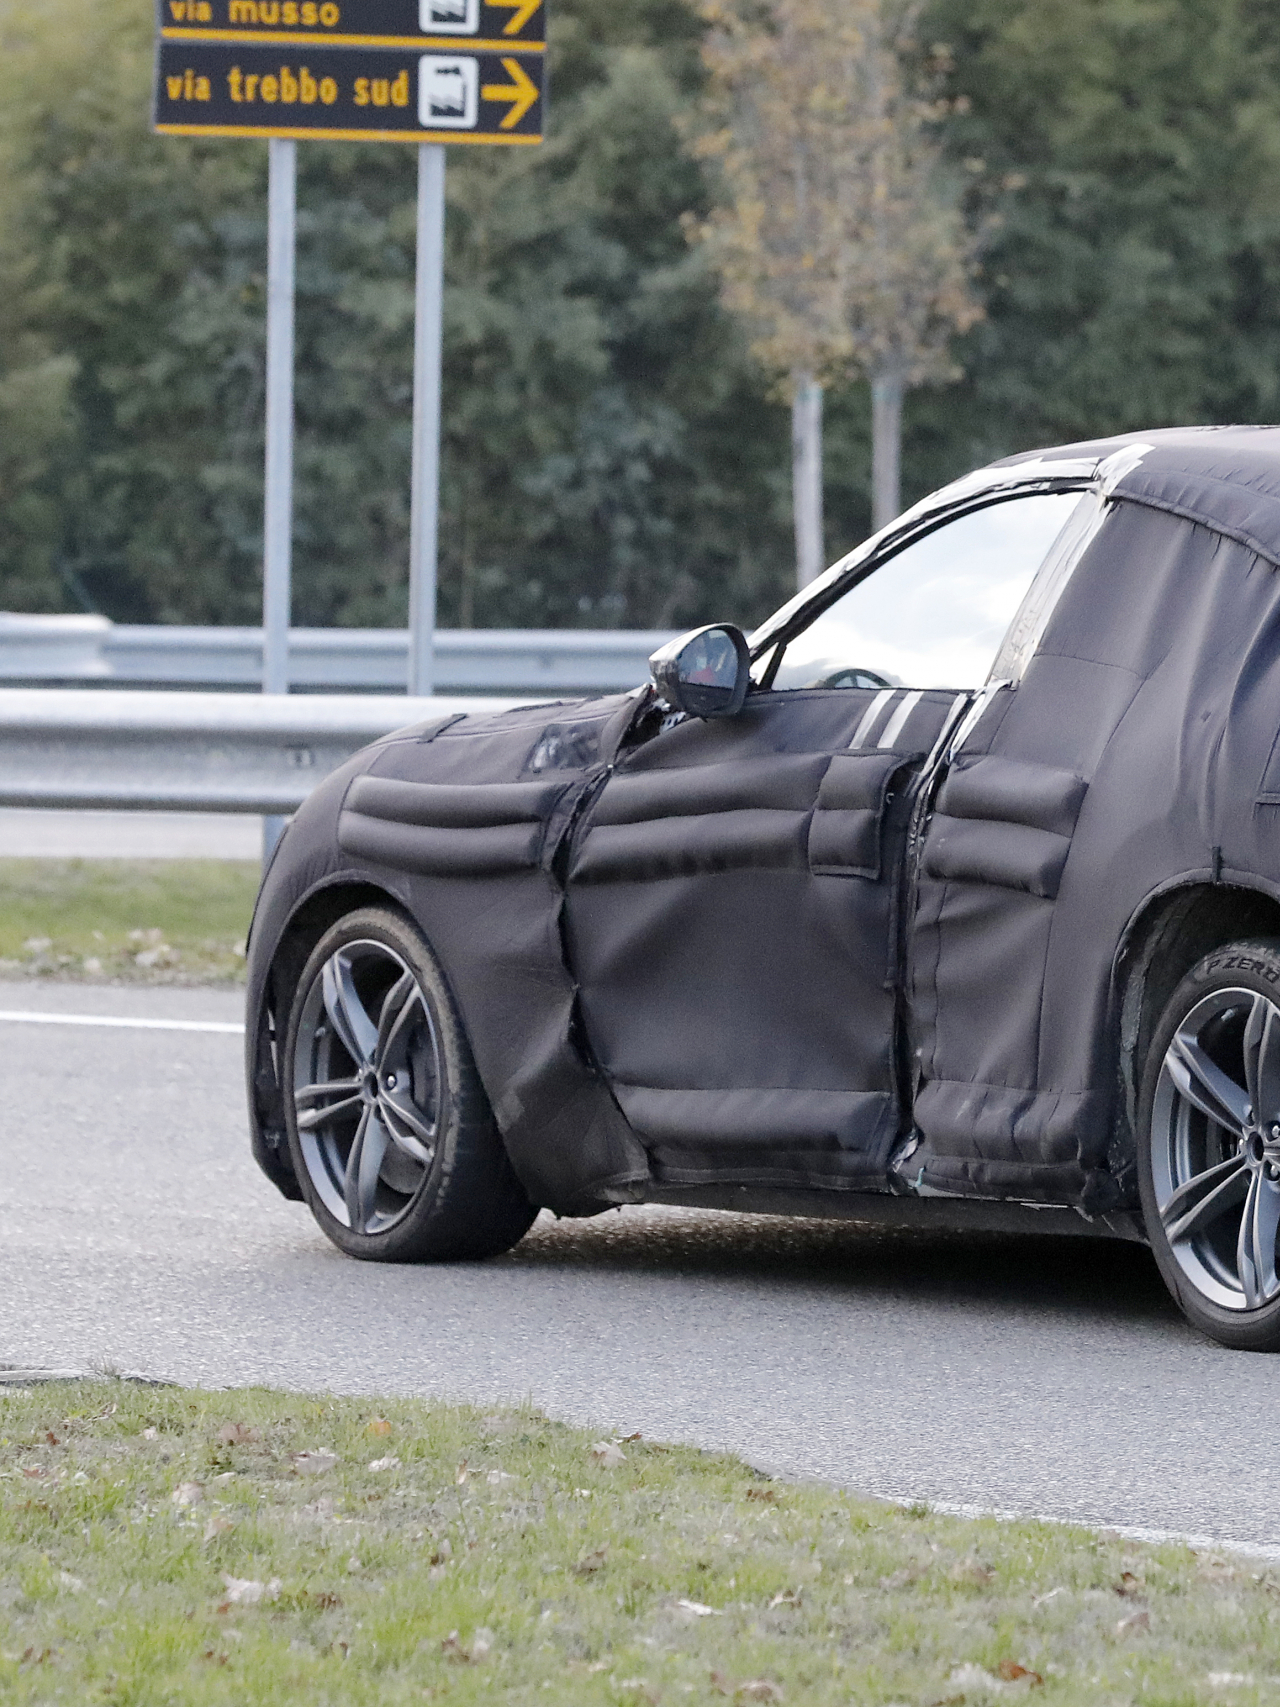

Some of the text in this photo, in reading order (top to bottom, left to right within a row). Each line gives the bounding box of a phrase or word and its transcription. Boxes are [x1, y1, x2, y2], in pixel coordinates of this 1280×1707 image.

[169, 0, 340, 27] via musso
[166, 66, 410, 107] via trebbo sud
[1222, 956, 1280, 984] ZERO
